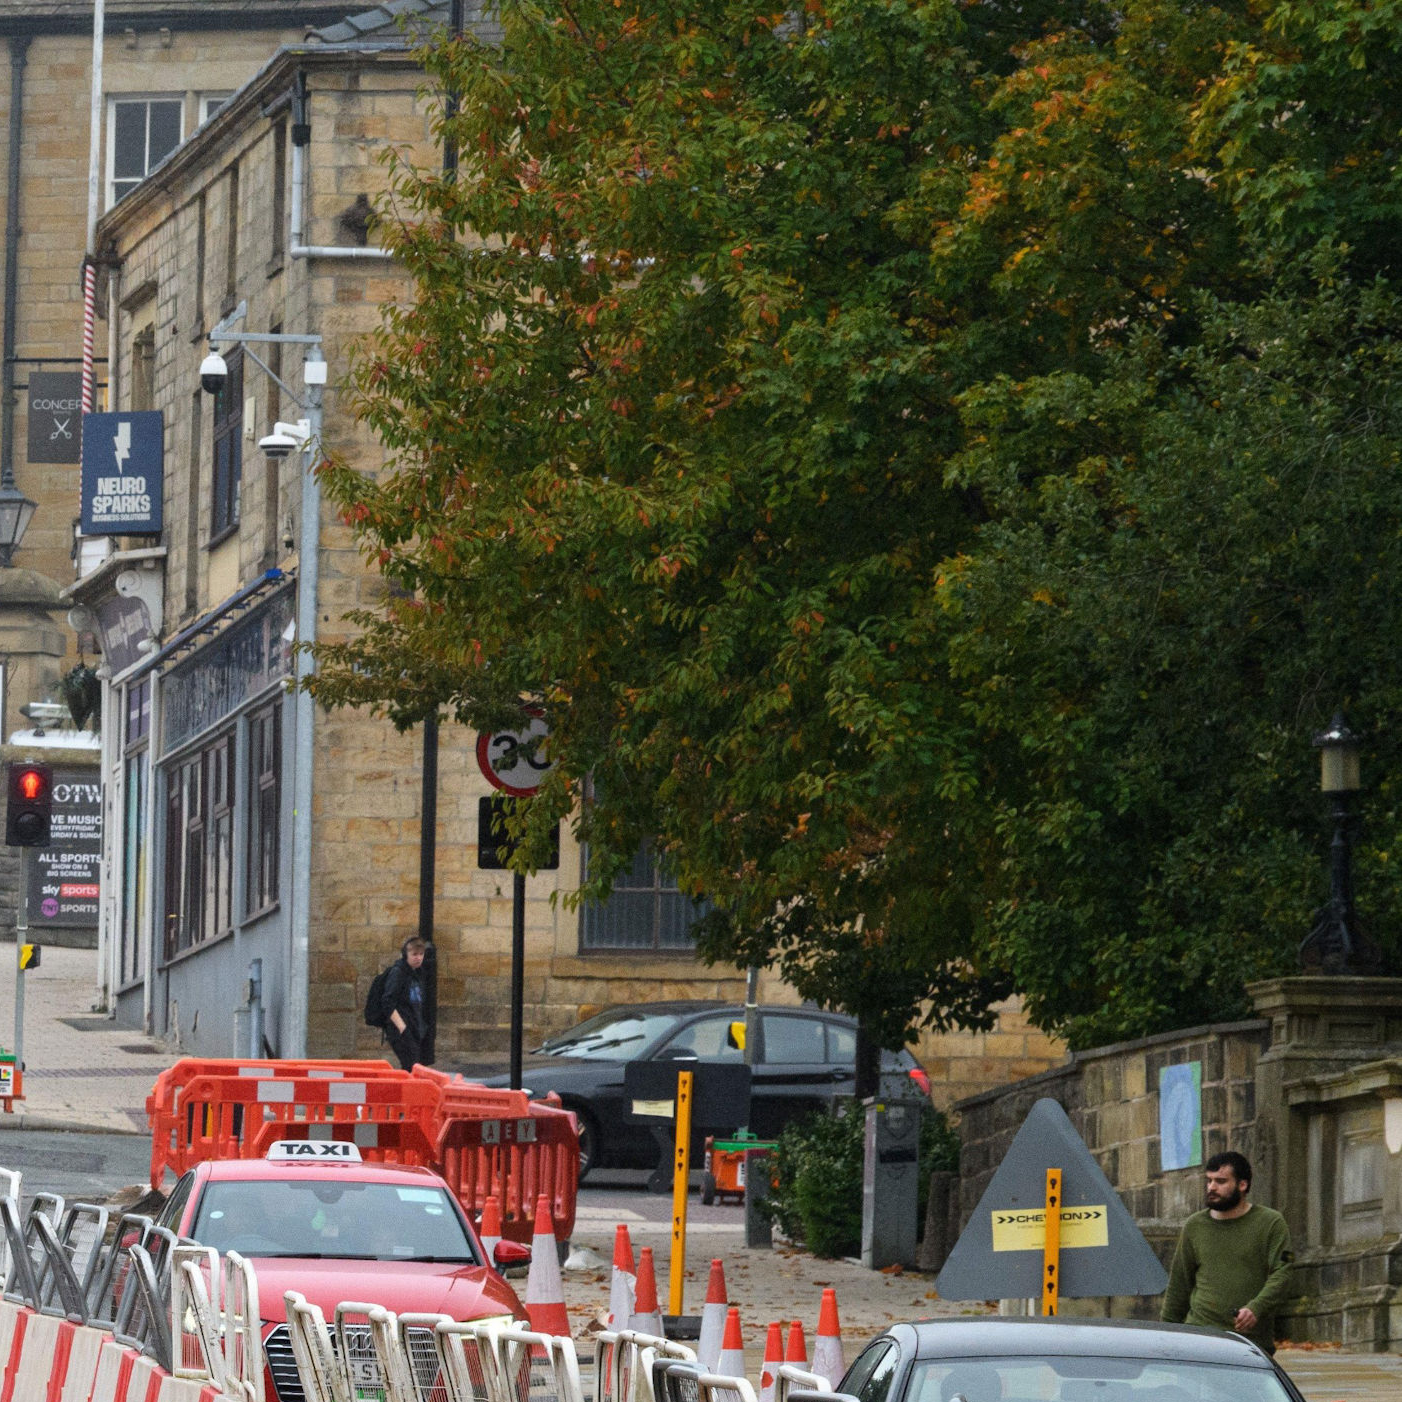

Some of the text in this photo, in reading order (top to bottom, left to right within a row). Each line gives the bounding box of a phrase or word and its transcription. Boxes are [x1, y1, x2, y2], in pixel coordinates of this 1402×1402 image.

[97, 476, 147, 496] NEURO
[91, 495, 151, 514] SPARKS
[67, 815, 103, 825] MUSIC
[38, 853, 102, 864] ALL SPORTS
[42, 884, 98, 897] sky sports
[59, 904, 98, 913] SPORTS
[280, 1143, 350, 1156] TAXI
